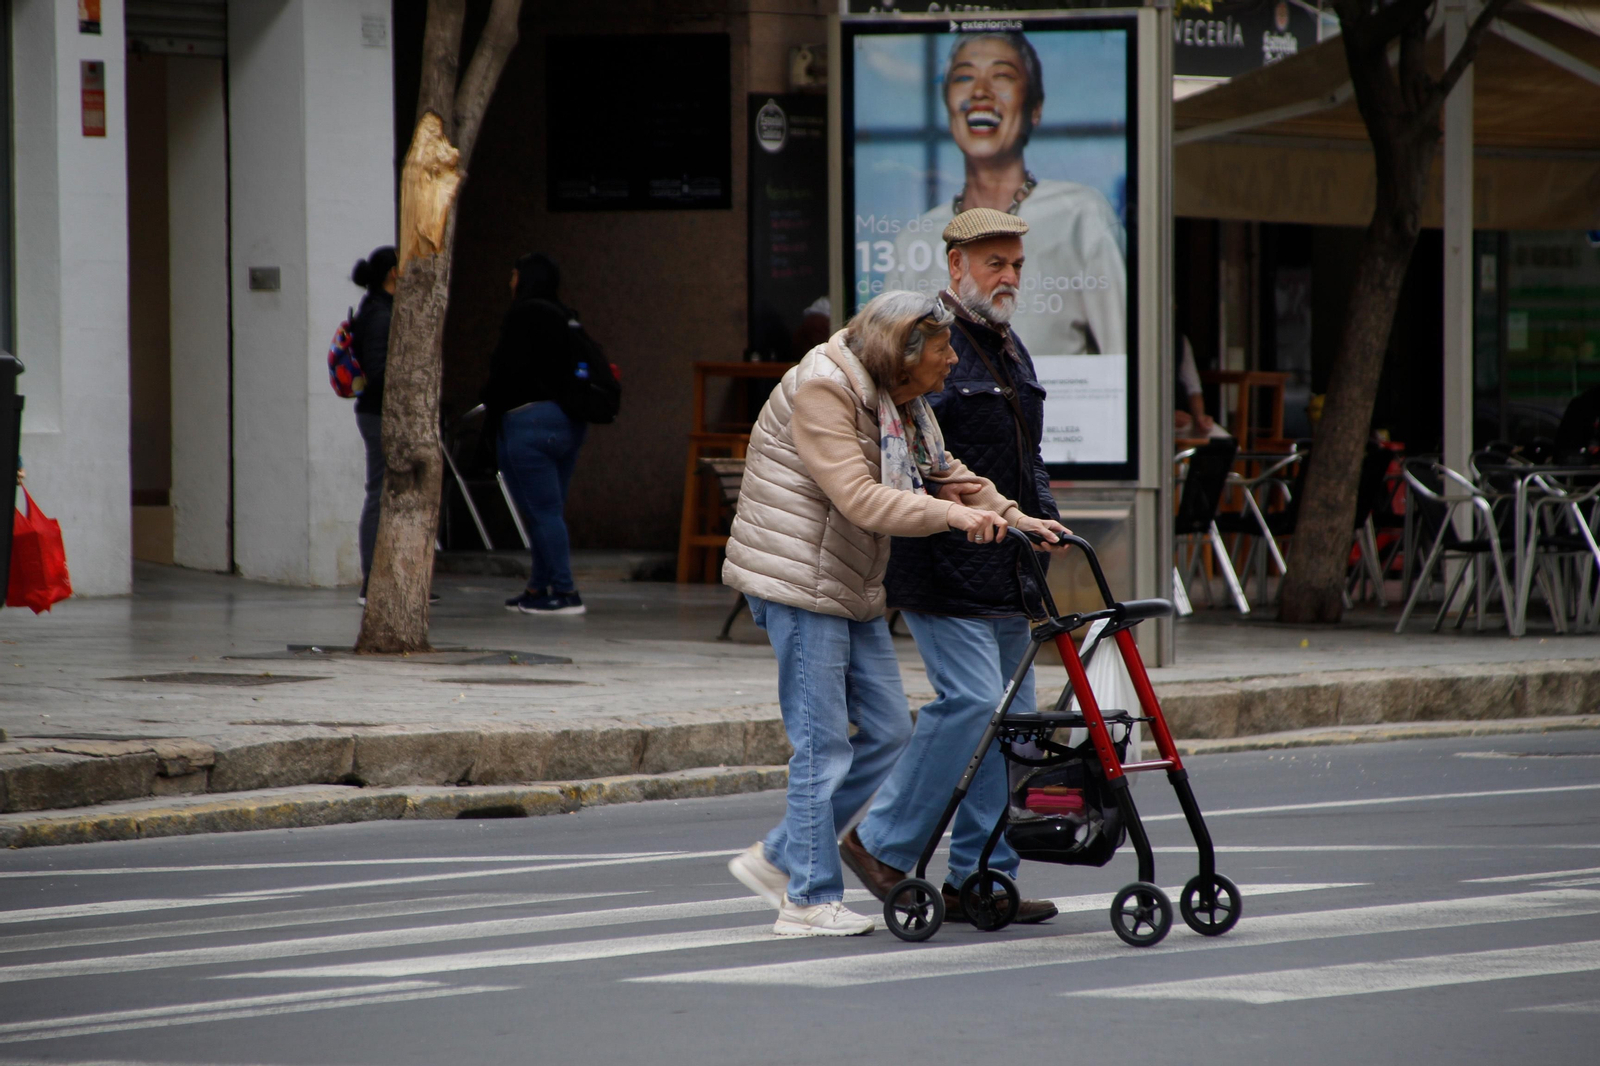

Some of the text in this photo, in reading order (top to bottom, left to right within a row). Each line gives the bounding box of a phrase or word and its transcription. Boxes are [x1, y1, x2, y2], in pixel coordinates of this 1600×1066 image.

[961, 19, 1023, 31] exteriorplus
[856, 213, 934, 234] Más de
[857, 273, 884, 294] de
[1032, 293, 1064, 313] 50
[1046, 425, 1080, 433] BELLEZA
[1053, 435, 1084, 443] MUNDO
